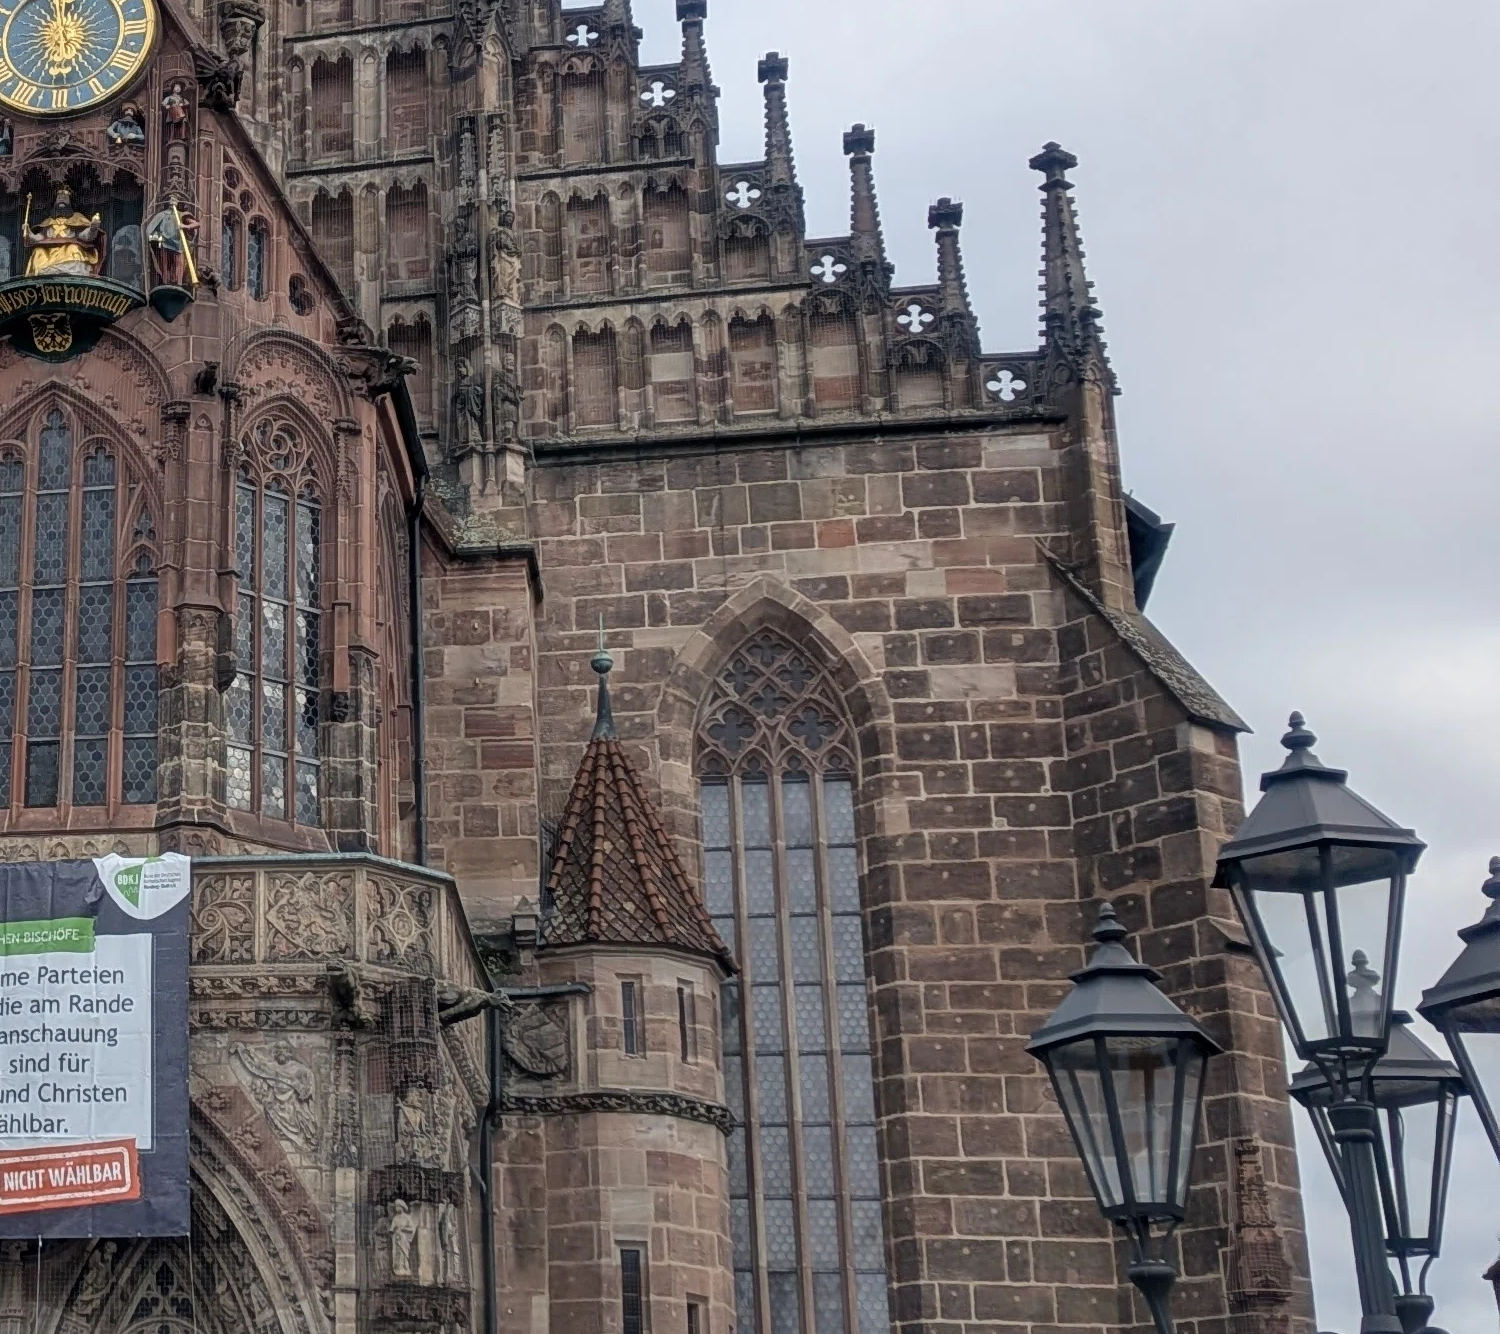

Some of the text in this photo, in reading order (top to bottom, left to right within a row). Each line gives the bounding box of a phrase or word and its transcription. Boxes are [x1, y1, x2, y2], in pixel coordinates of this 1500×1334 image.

[117, 873, 138, 885] BDKJ
[23, 928, 79, 943] BISCHÖFE
[37, 966, 124, 985] Parteien
[29, 999, 60, 1014] am
[69, 994, 134, 1014] Rande
[9, 1055, 50, 1074] sind
[58, 1054, 91, 1073] für
[37, 1083, 127, 1103] Christen
[3, 1161, 121, 1192] NICHT WÄHLBAR
